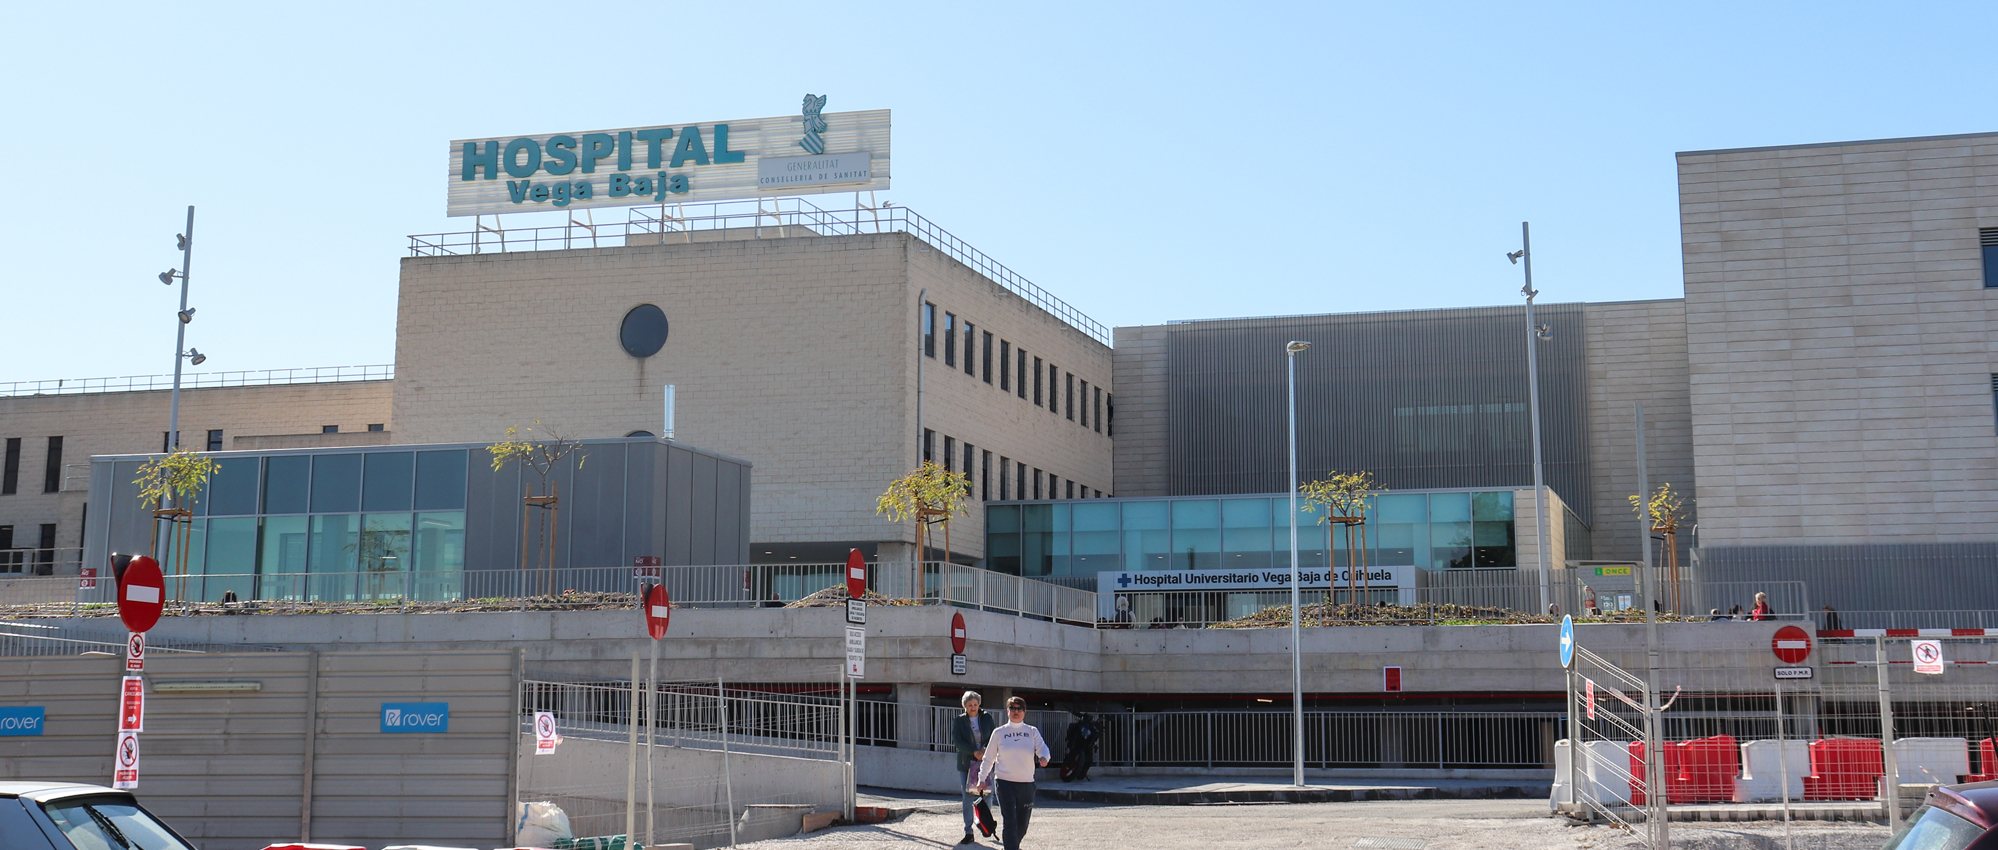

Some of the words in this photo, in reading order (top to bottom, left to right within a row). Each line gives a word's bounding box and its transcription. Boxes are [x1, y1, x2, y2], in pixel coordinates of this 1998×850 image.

[462, 123, 745, 181] HOSPITAL
[787, 159, 839, 172] GENERALITAT
[760, 174, 813, 184] CONSELLERIA
[834, 170, 867, 179] SANITAT
[506, 180, 592, 207] Vega
[609, 171, 689, 202] Baja
[1134, 573, 1182, 588] Hospital
[1185, 573, 1259, 586] Universitario
[1262, 572, 1292, 585] Vega
[1342, 569, 1392, 582] Oihuela
[1, 717, 40, 729] rover
[403, 714, 444, 726] rover
[1004, 731, 1030, 739] NIKE
